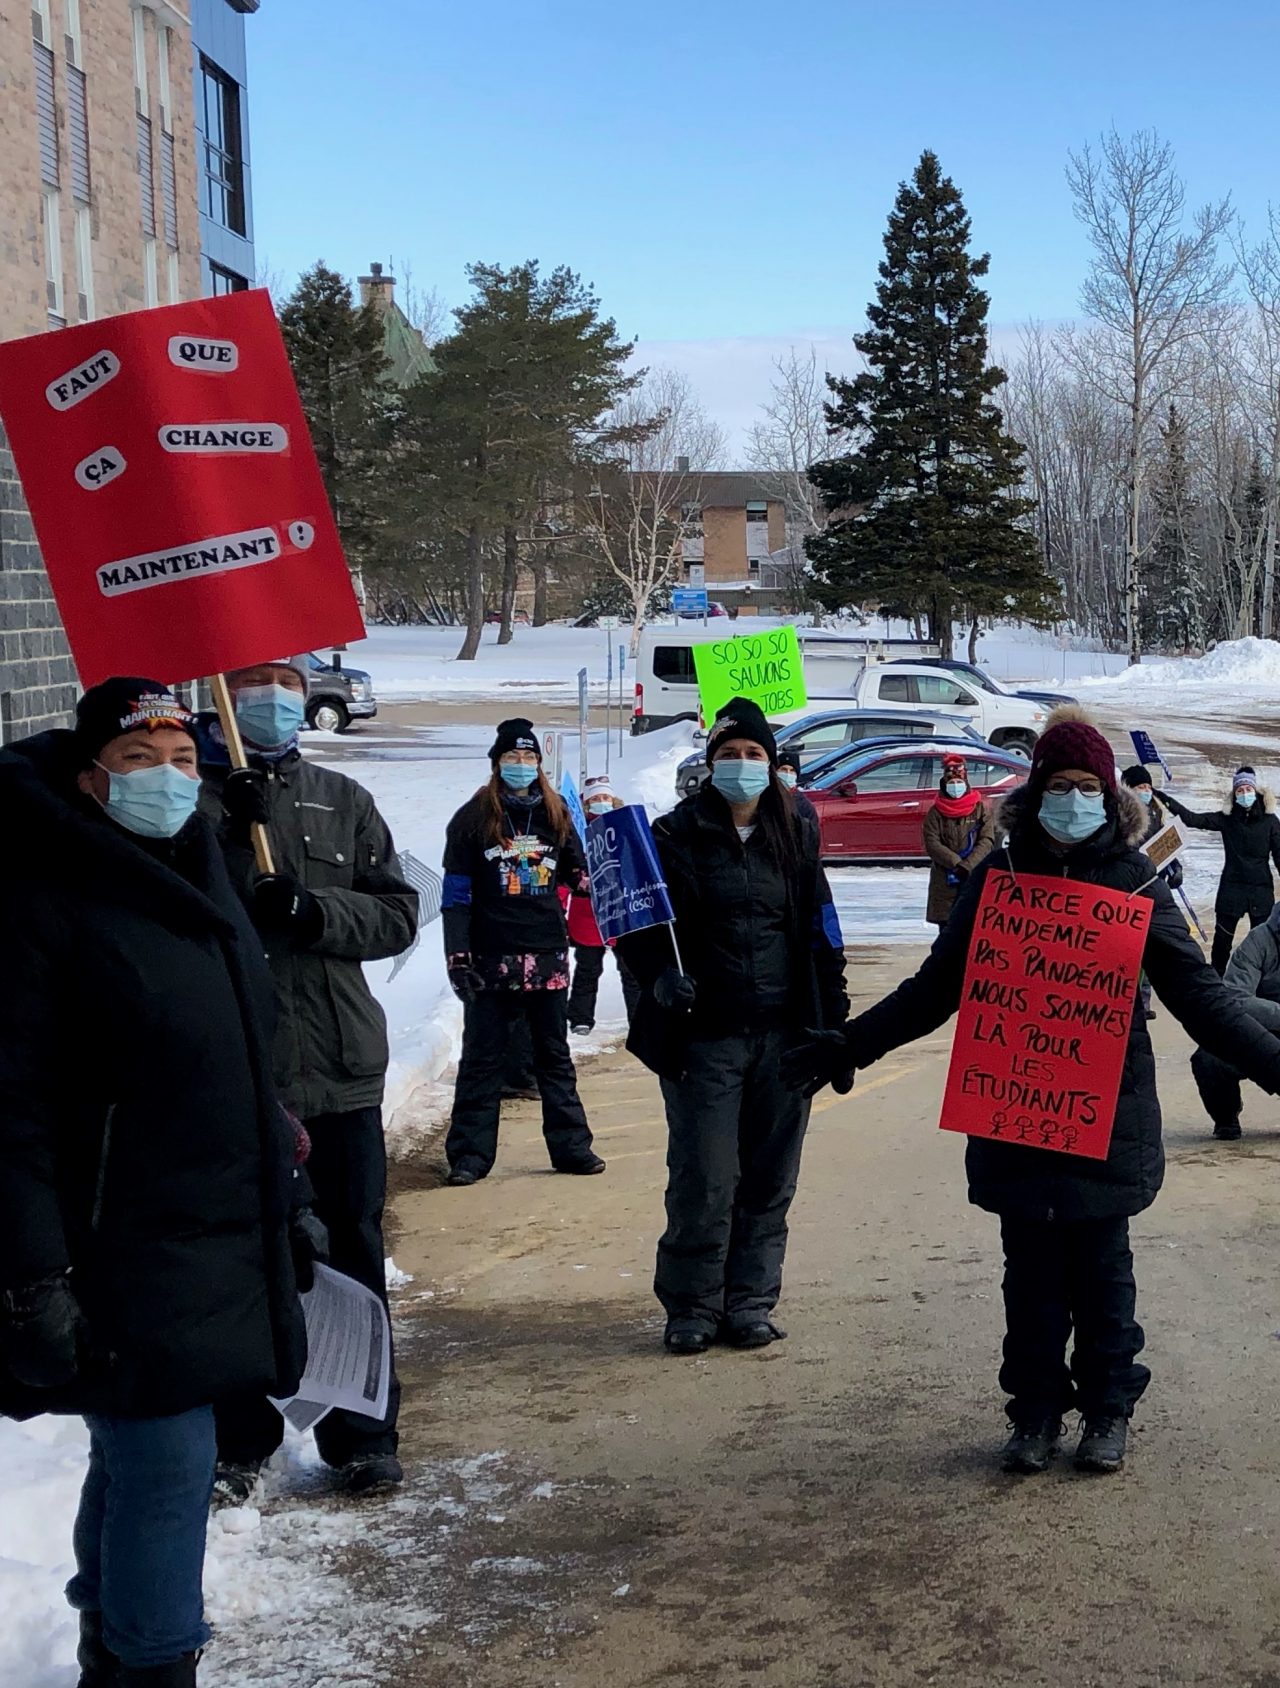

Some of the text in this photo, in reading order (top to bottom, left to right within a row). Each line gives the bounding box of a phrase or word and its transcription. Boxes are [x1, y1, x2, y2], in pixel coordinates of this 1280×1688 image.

[54, 342, 232, 402] FAUT QUE
[84, 430, 273, 483] ÇA CHANGE
[100, 536, 277, 588] MAINTENANT
[712, 632, 788, 665] SO SO SO
[729, 658, 791, 691] SAUVONS
[760, 688, 794, 713] JOBS
[990, 875, 1146, 930] PARCE QUE
[974, 939, 1010, 971] PAS
[981, 906, 1100, 952] PANDÉMIE
[969, 979, 1129, 1037] NOUS SOMMES
[973, 1013, 1090, 1066] LÀ POUR
[1011, 1054, 1055, 1082] LES
[962, 1064, 1101, 1125] ÉTUDIANTS
